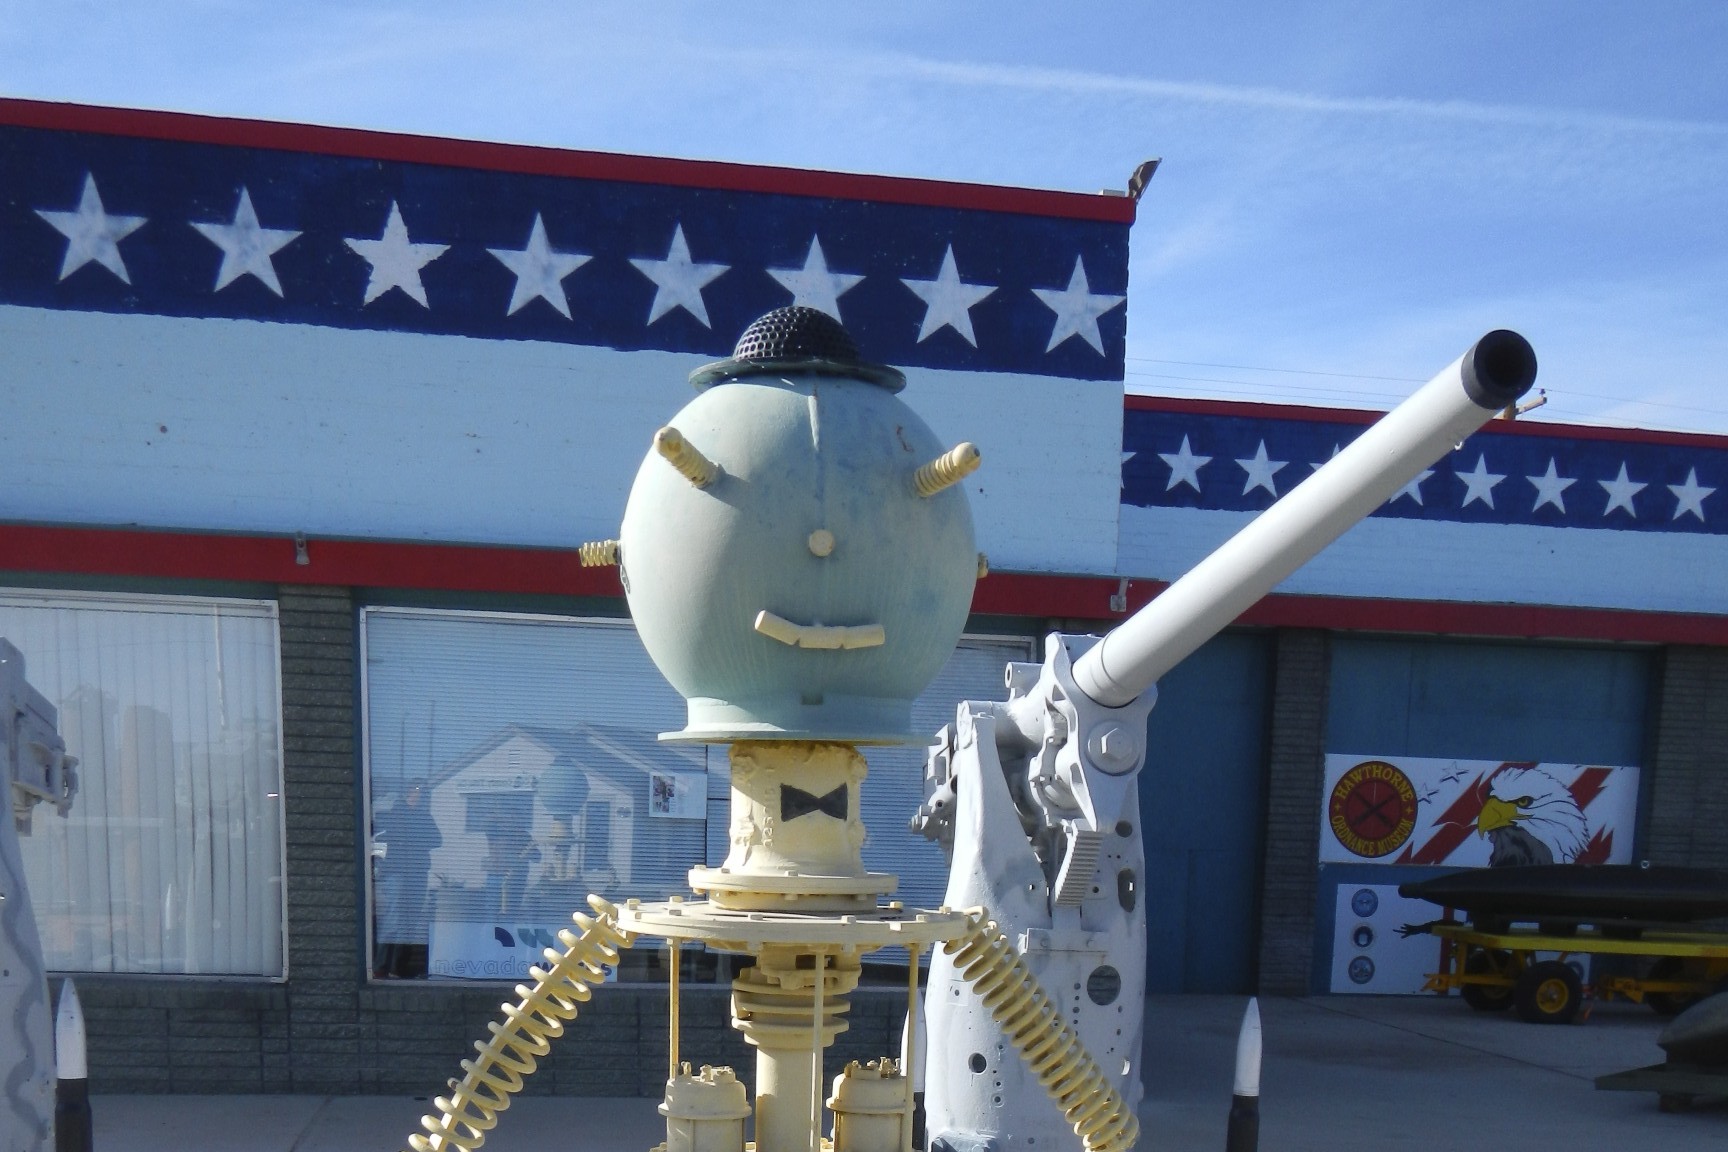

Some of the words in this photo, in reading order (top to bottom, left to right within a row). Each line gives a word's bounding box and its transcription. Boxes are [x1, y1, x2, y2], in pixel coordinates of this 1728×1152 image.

[1335, 765, 1414, 802] HAWTHORNE
[1332, 816, 1375, 856] ORDNANCE
[1377, 818, 1414, 854] MUSEUM
